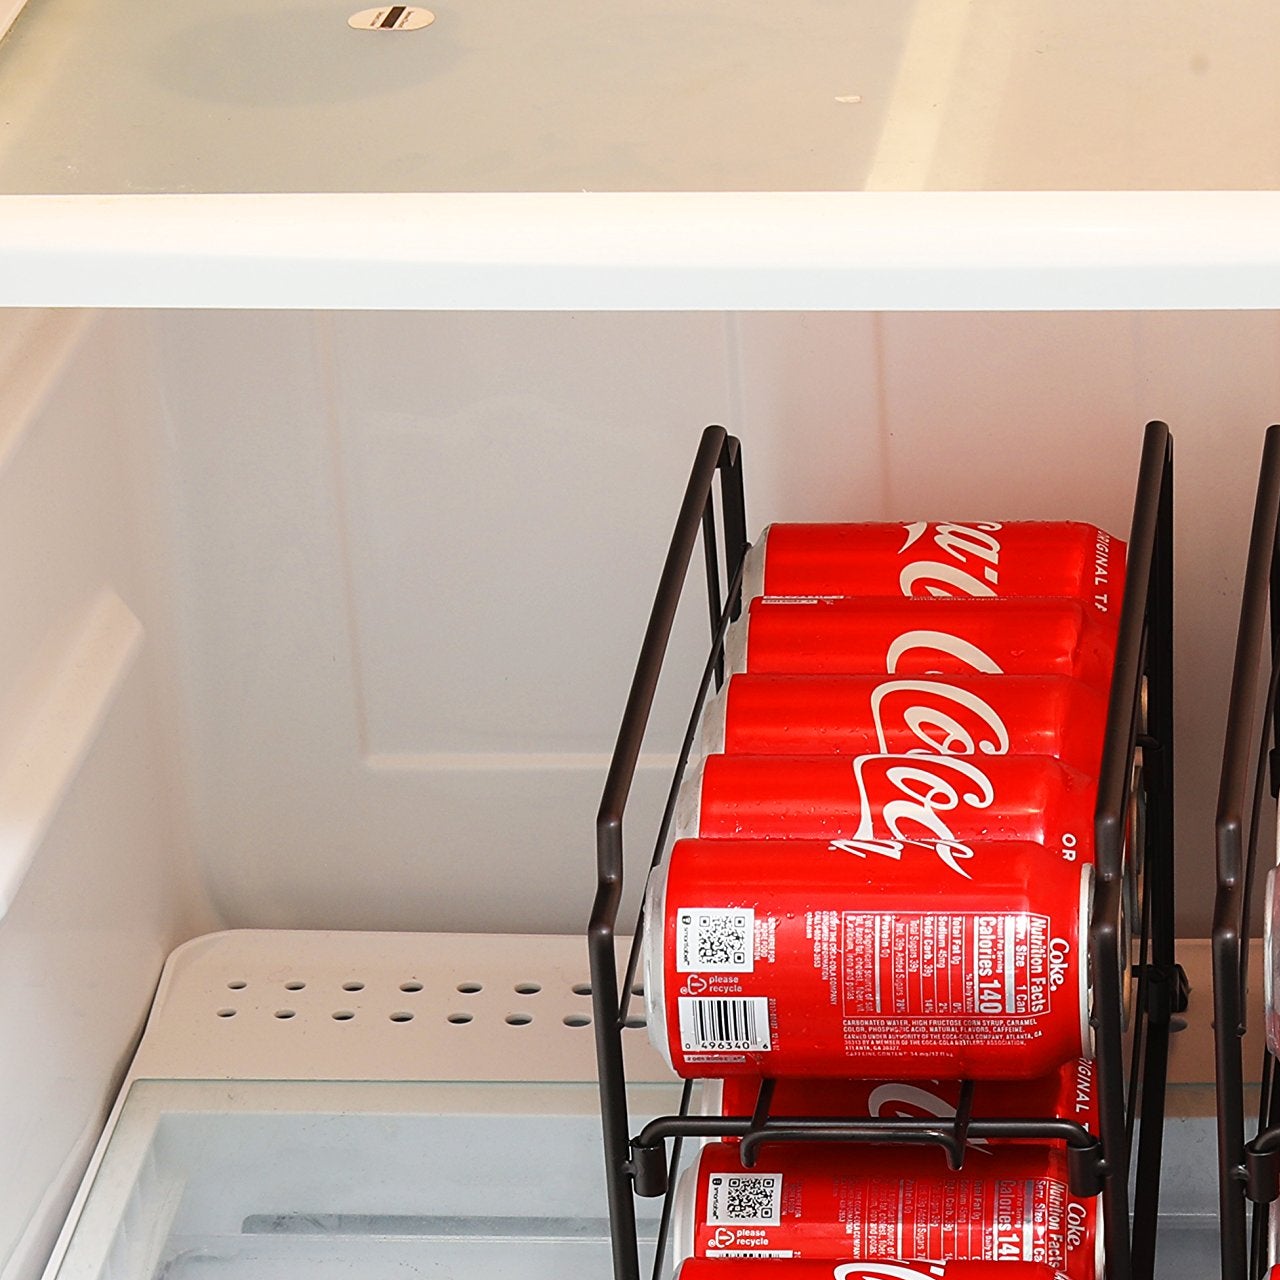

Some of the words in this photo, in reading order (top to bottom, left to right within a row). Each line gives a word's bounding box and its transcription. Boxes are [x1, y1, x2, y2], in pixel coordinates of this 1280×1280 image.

[881, 916, 891, 947] Protein
[910, 920, 919, 934] Total
[924, 916, 933, 937] Total
[938, 916, 948, 947] Sodium
[952, 916, 961, 937] Total
[908, 936, 919, 958] Sugars
[924, 939, 933, 962] Carb.
[952, 940, 961, 954] Fat
[979, 916, 997, 976] Calories
[1031, 917, 1047, 973] Nutrition
[908, 960, 919, 972] 39g
[1015, 945, 1027, 967] Size
[709, 985, 742, 993] recycle
[980, 980, 1002, 1013] 140
[1031, 977, 1046, 1012] Facts
[925, 999, 934, 1013] 14%
[1017, 994, 1027, 1013] Can
[701, 1042, 749, 1050] 496340
[1035, 1180, 1046, 1200] Serv.
[998, 1181, 1016, 1231] Calories
[1034, 1203, 1046, 1222] Size
[1049, 1181, 1064, 1230] Nutrition
[736, 1229, 766, 1237] please
[736, 1239, 768, 1247] recycle
[1048, 1234, 1063, 1268] Facts
